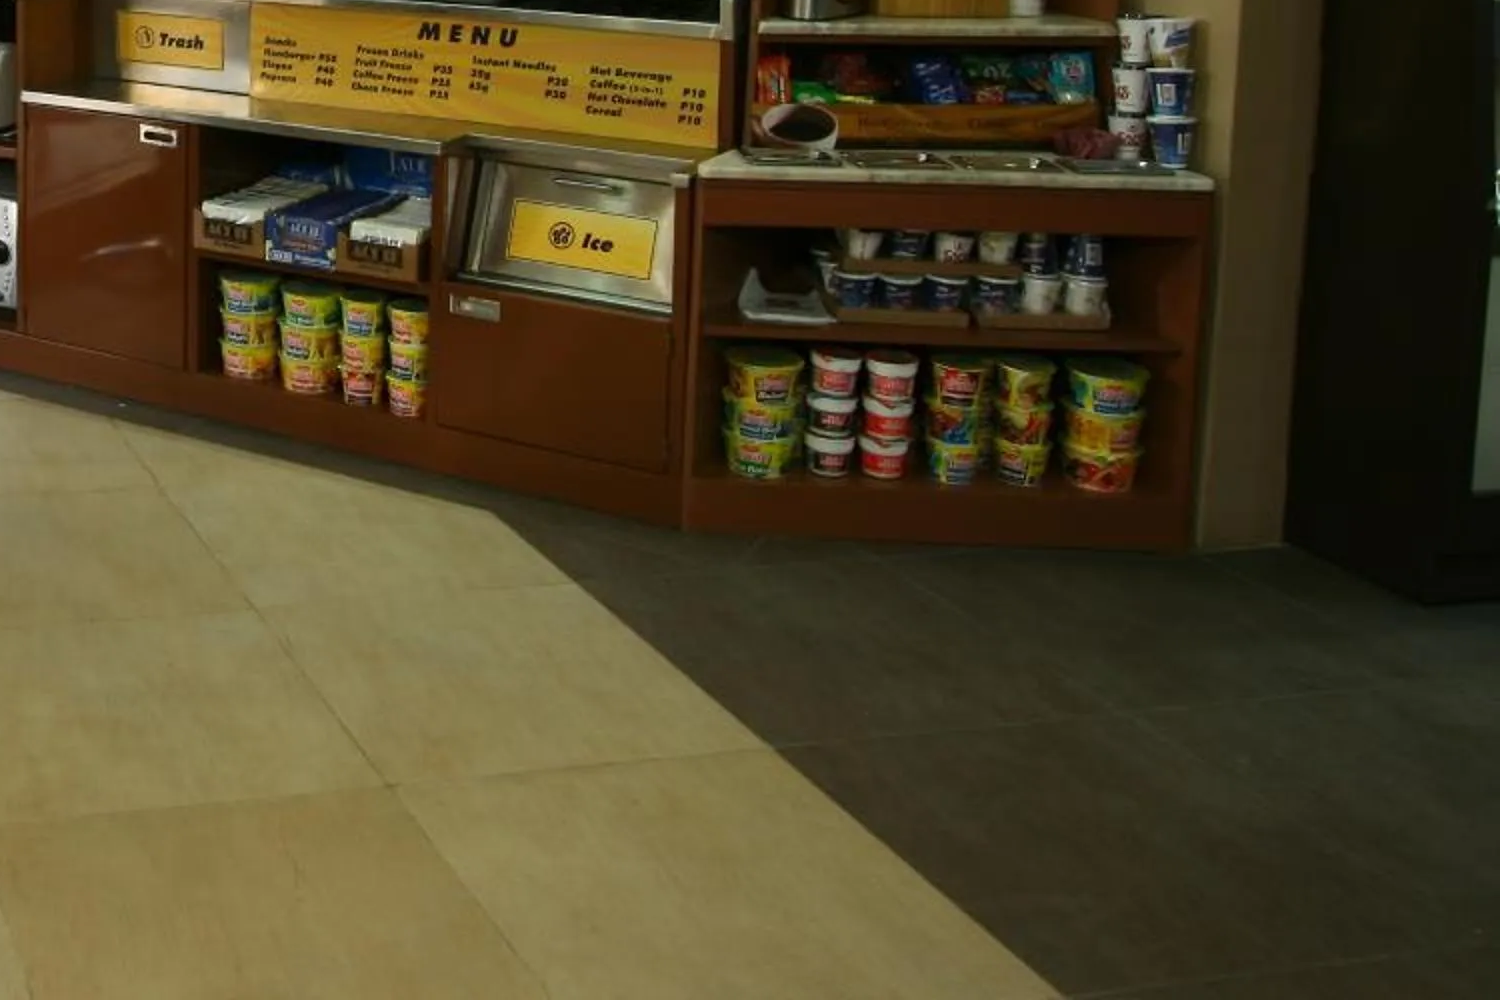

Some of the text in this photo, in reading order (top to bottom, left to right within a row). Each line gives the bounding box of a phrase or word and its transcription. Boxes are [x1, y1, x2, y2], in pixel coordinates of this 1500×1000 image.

[159, 31, 205, 51] Trash
[417, 21, 519, 48] MENU
[472, 55, 557, 73] Instant Noodles
[589, 64, 673, 83] Hot Beverage
[589, 79, 626, 92] Coffee
[682, 87, 707, 100] P10
[587, 91, 704, 113] Hot Chocolate P10
[585, 104, 702, 127] Cereal P10
[581, 233, 614, 253] Ice
